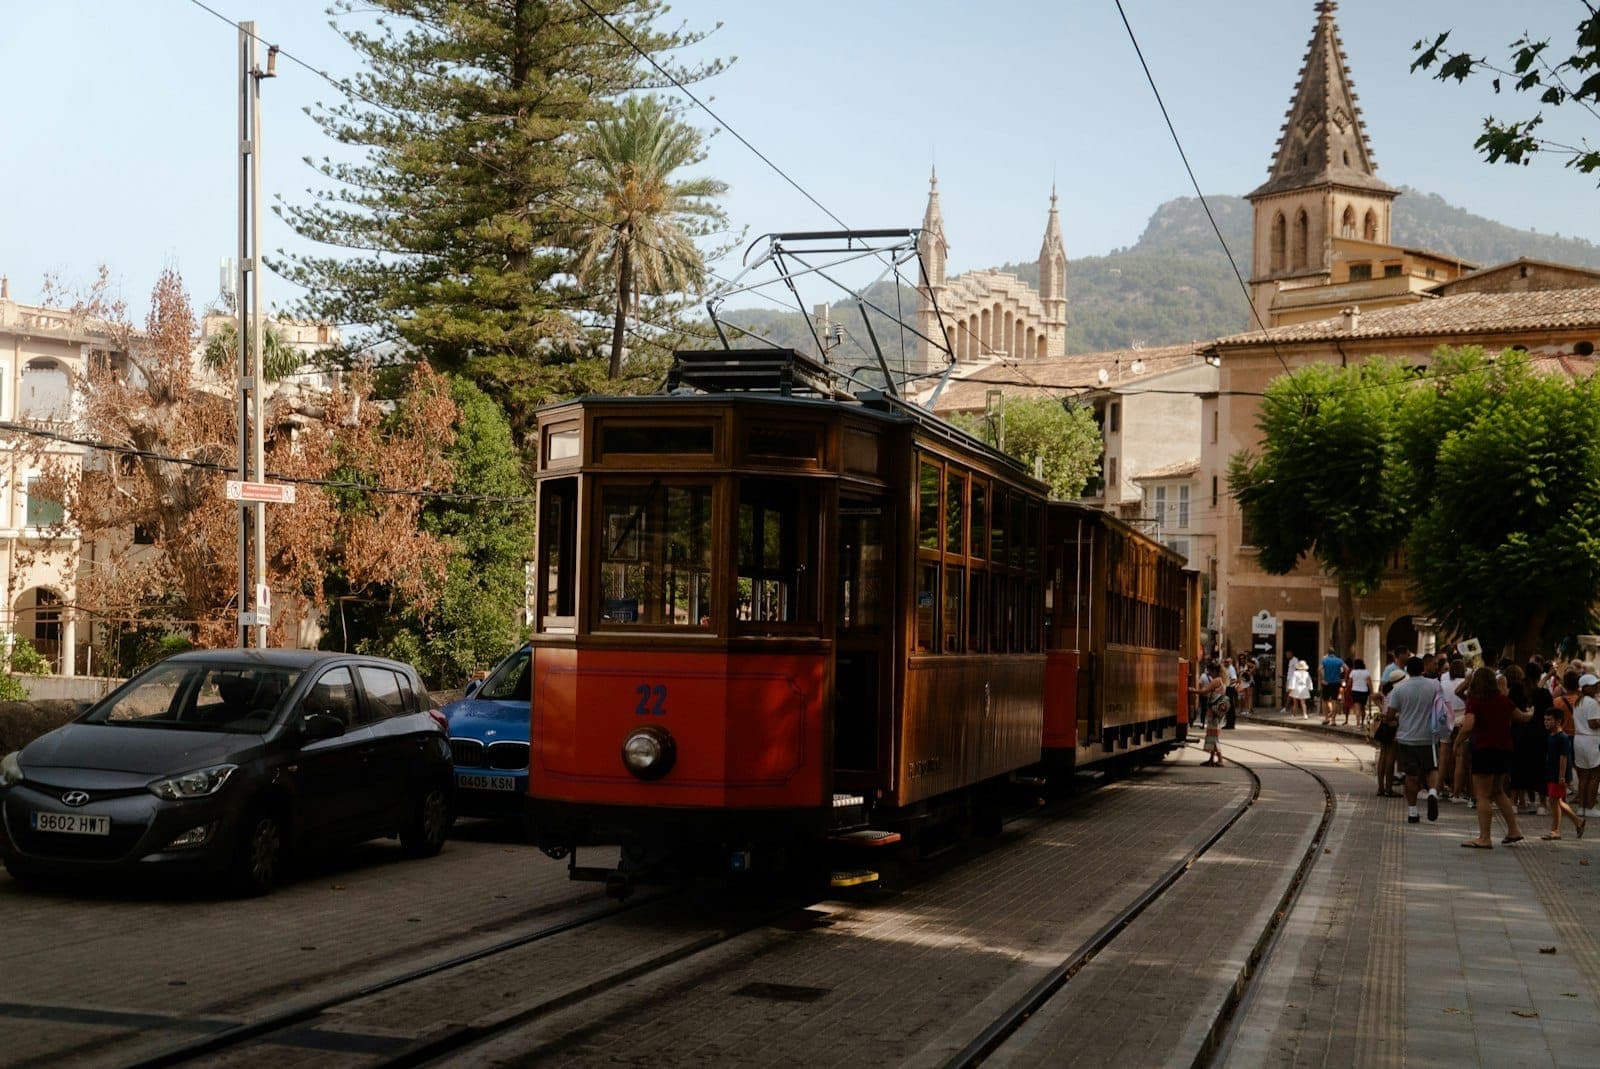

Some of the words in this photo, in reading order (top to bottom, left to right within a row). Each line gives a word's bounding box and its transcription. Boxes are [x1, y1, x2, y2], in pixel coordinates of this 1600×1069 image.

[635, 684, 667, 716] 22
[460, 775, 488, 789] 0405
[491, 776, 513, 790] KSN
[39, 814, 75, 831] 9602
[79, 817, 106, 833] HWT
